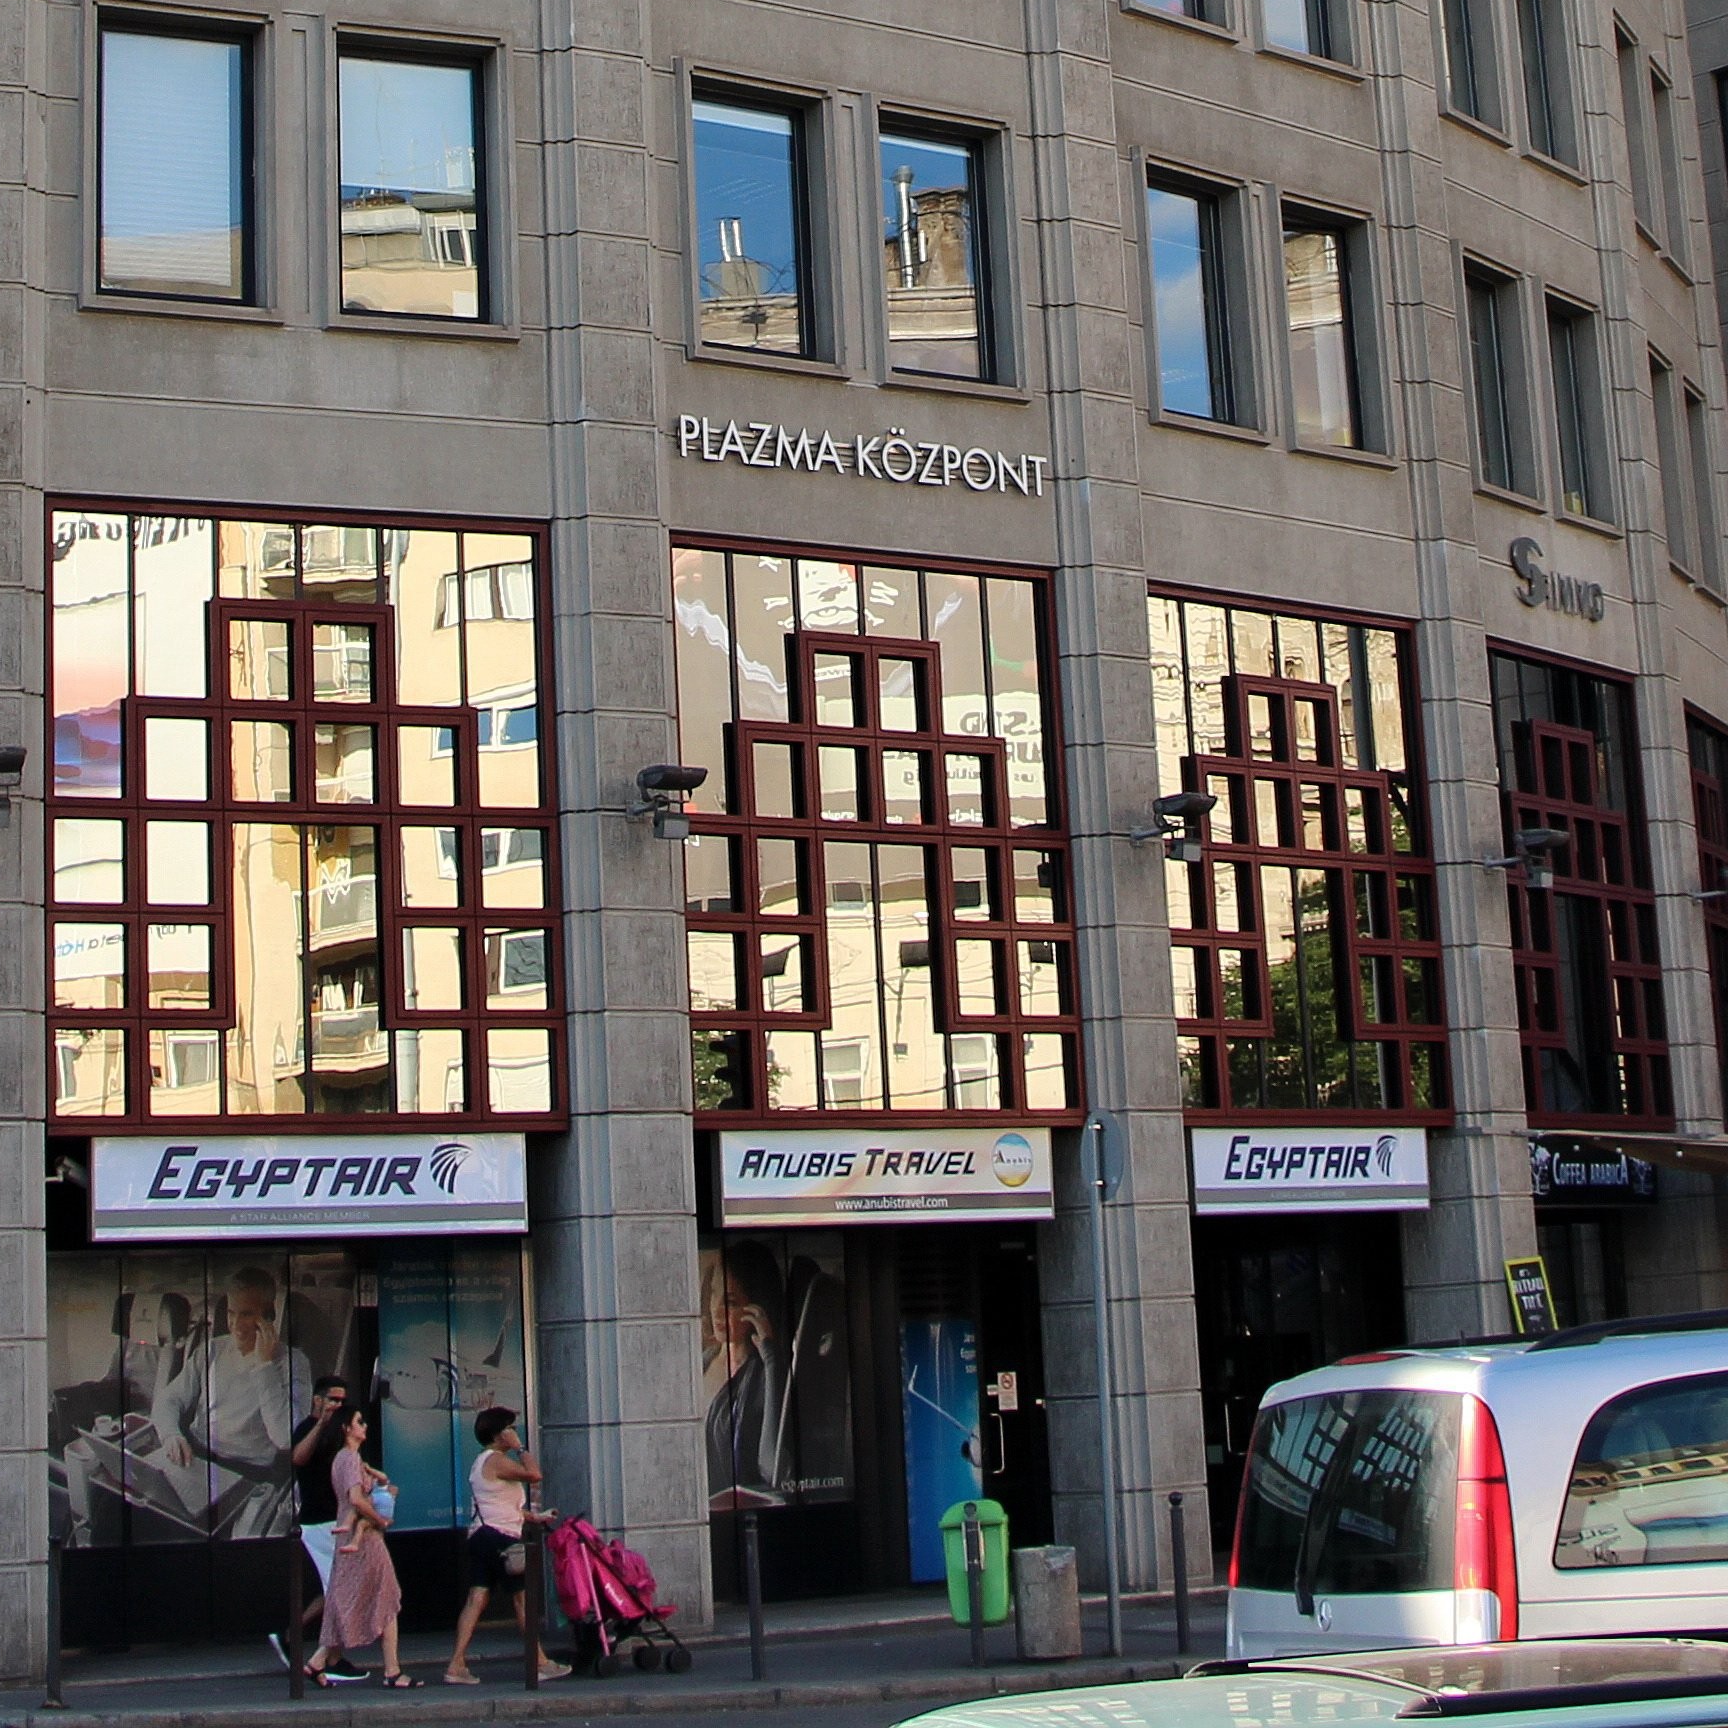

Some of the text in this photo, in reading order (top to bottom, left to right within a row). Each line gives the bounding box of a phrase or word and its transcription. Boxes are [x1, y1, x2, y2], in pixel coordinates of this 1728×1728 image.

[678, 413, 1048, 497] PLAZMA KÖZPONT
[146, 1145, 423, 1200] EGYPTAIR
[738, 1147, 977, 1179] ANUBIS TRAVEL
[1223, 1135, 1372, 1180] EGYPTAIR
[1552, 1152, 1630, 1186] COFFEA ARABICA
[834, 1195, 949, 1211] www.anubistravel.com
